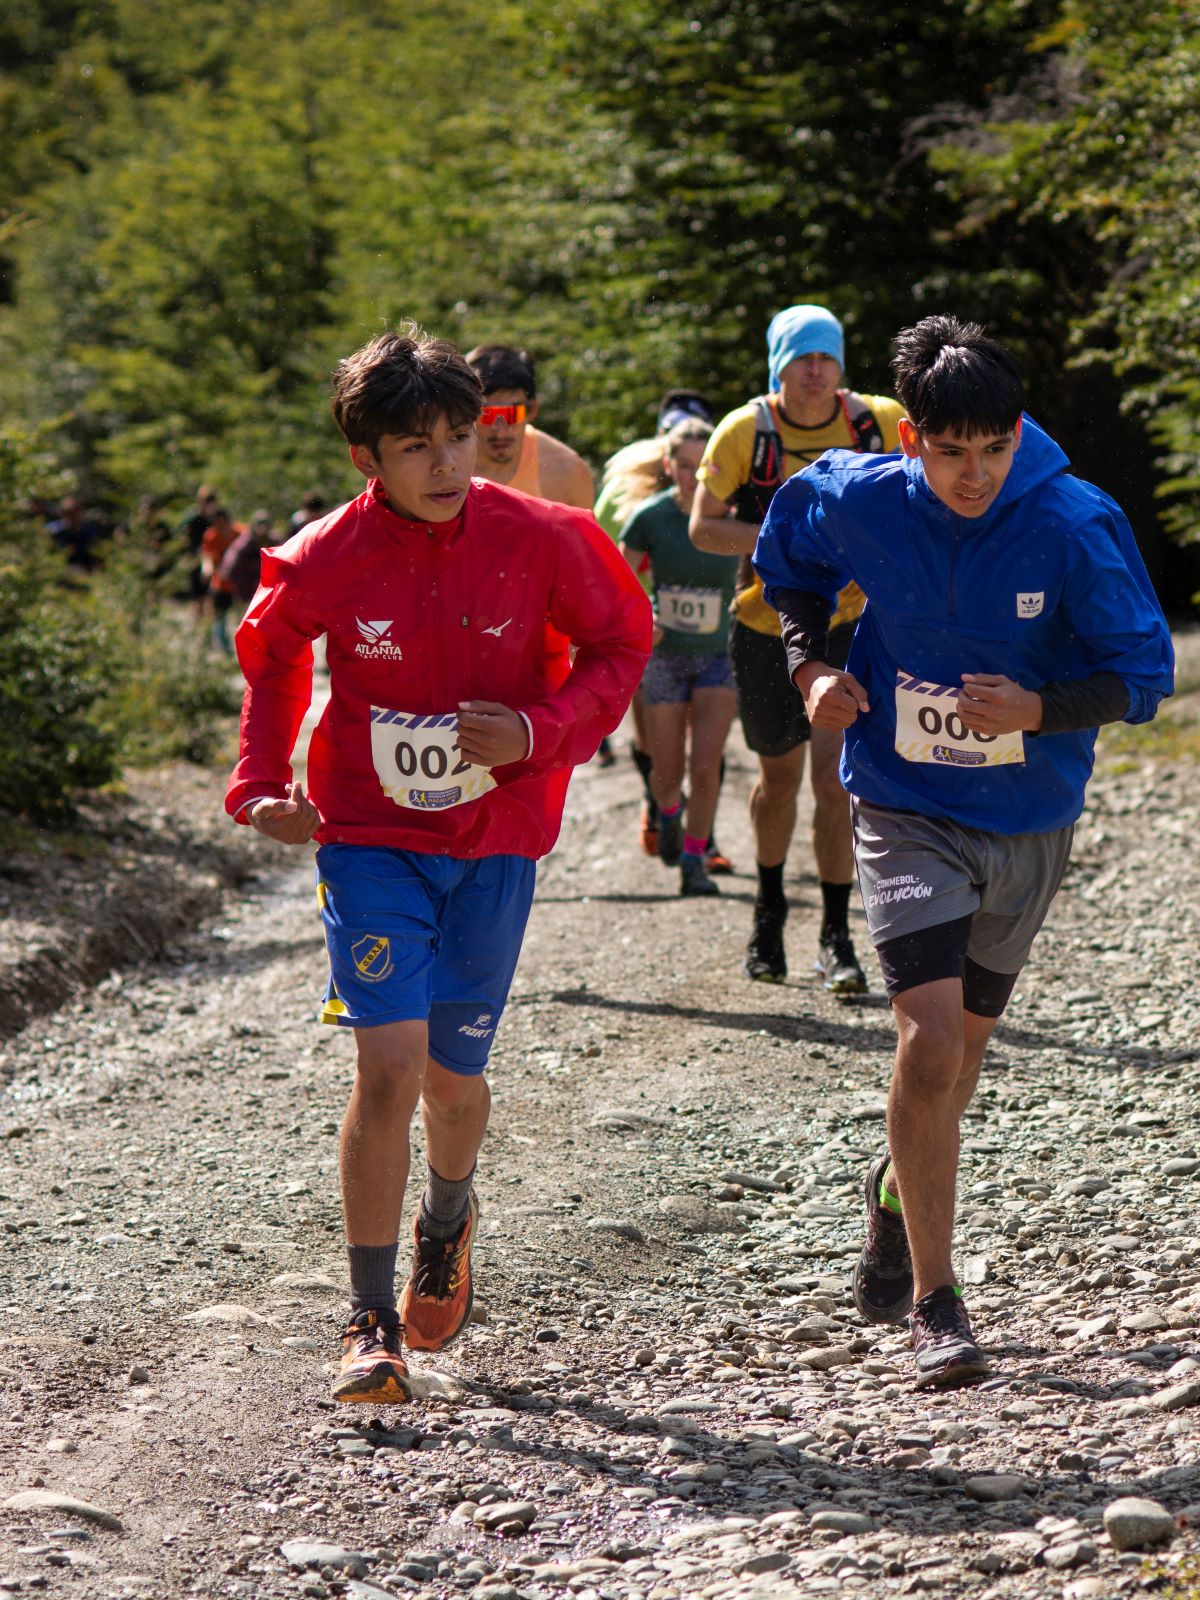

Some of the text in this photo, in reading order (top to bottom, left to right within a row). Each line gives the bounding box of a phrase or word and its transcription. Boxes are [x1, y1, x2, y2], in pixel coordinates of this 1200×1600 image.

[671, 598, 706, 618] 101
[354, 643, 402, 656] ATLANTA
[457, 1024, 493, 1038] FORT
